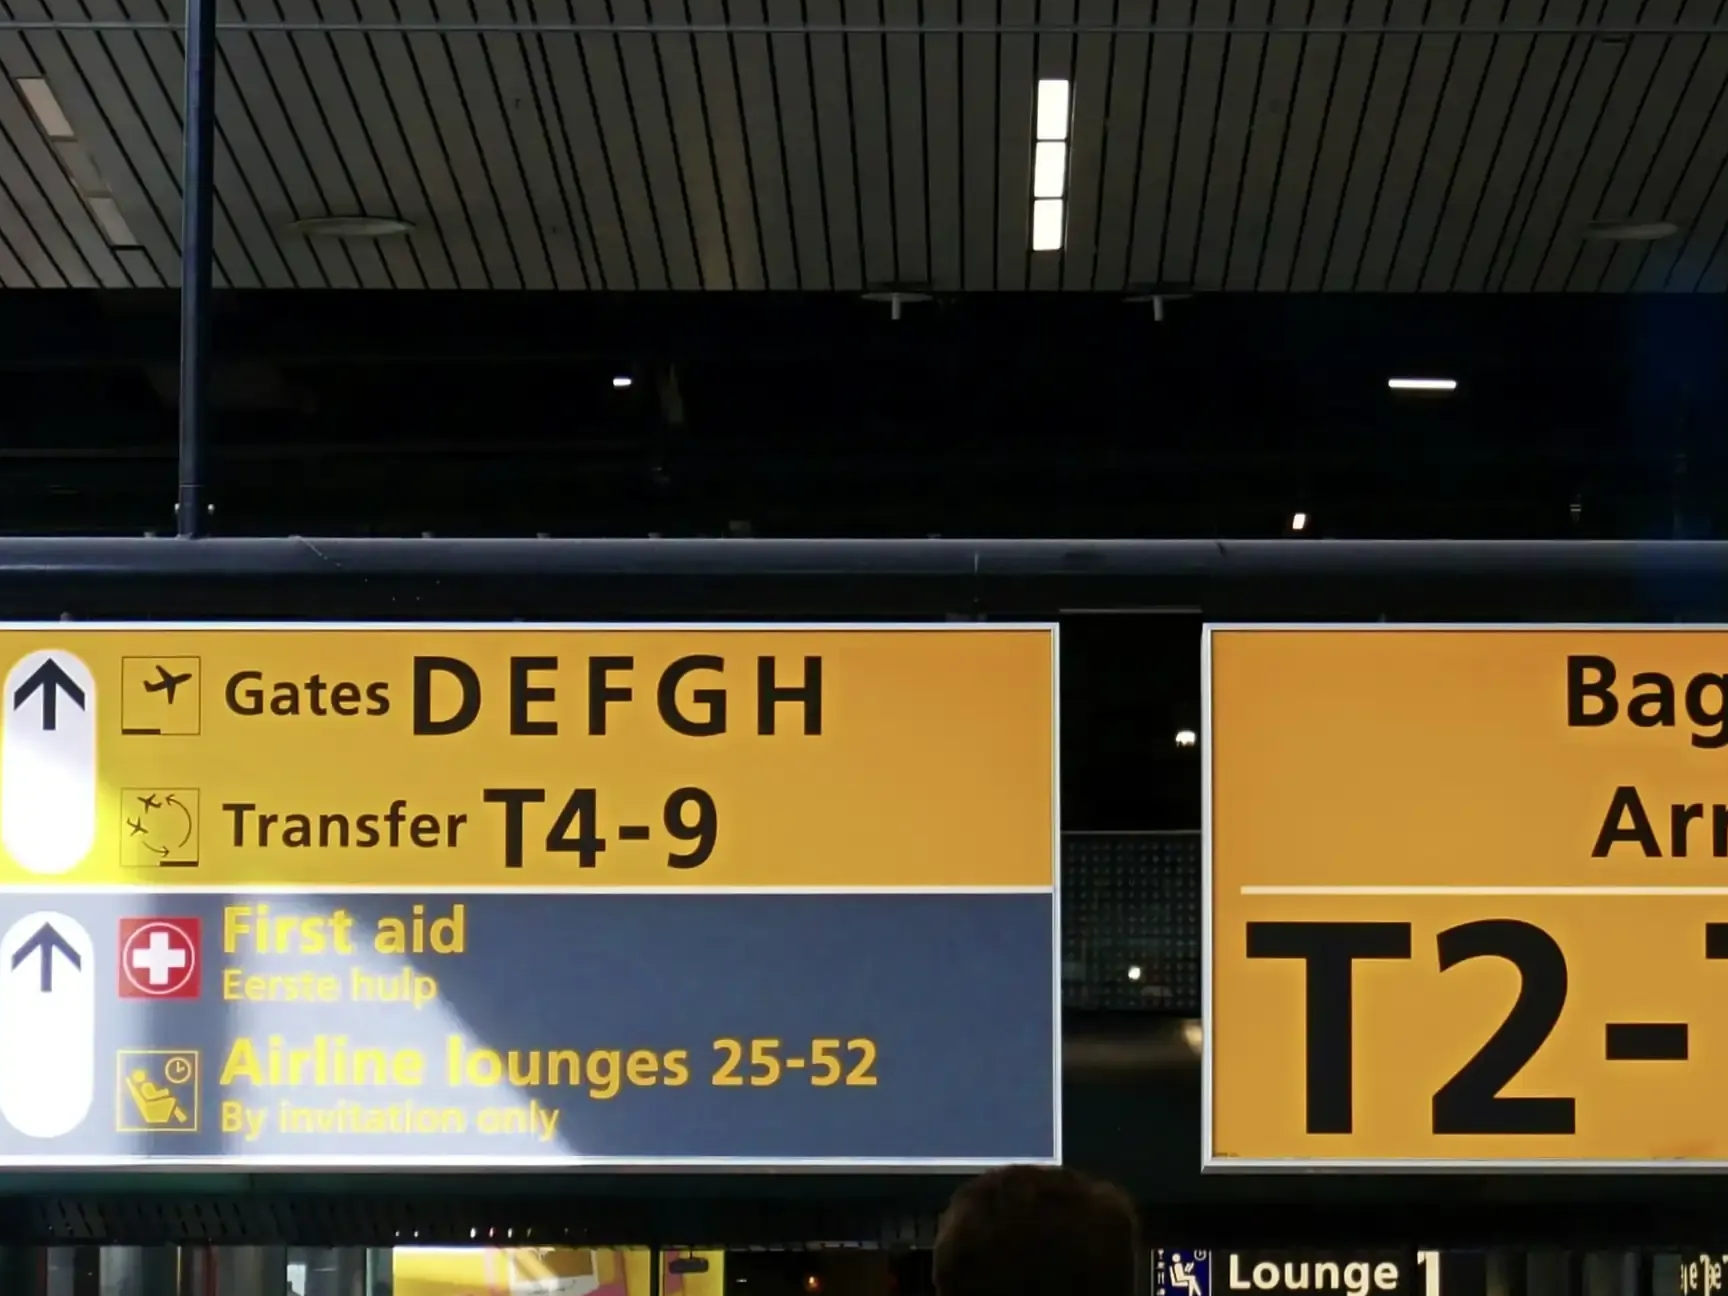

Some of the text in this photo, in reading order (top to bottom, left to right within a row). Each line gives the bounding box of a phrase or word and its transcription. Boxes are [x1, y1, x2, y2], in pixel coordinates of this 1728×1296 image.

[223, 670, 390, 716] Gates
[223, 787, 718, 869] Transfer T4-9
[223, 905, 464, 955] First aid
[223, 966, 438, 1009] Eerste hulp
[221, 1039, 876, 1100] Airline lounges 25-52
[223, 1097, 560, 1140] By invitation only
